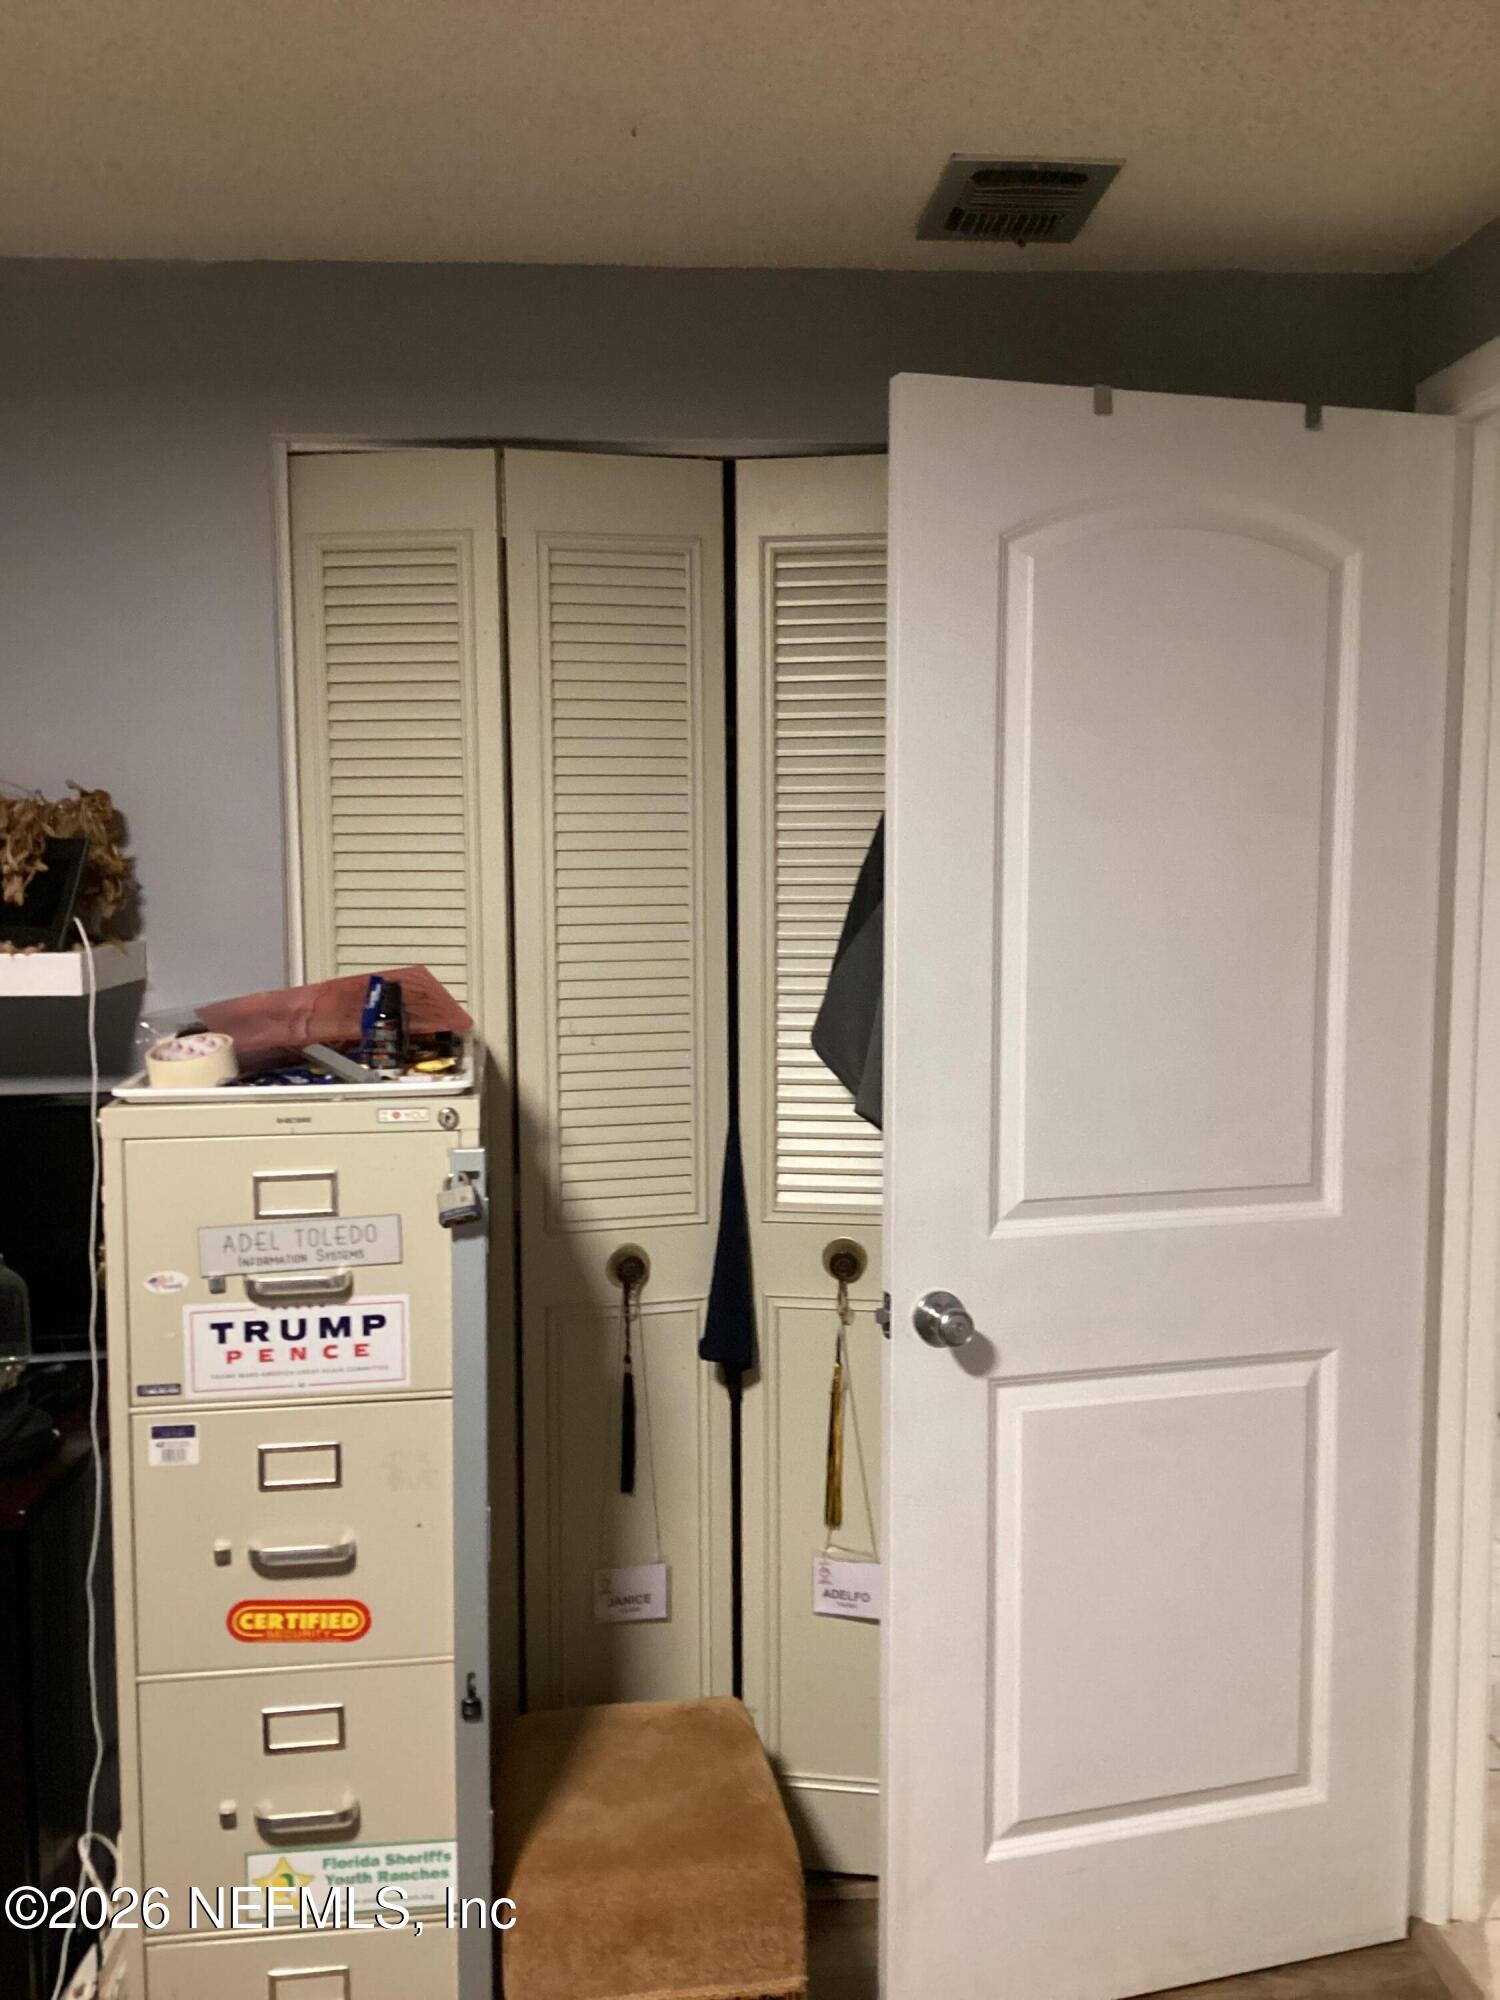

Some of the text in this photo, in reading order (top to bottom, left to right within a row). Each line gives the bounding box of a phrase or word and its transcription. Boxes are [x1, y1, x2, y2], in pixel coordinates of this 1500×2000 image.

[222, 1223, 378, 1254] ADEL TOLEDO
[209, 1313, 388, 1345] TRUMP
[225, 1343, 371, 1365] PENCE
[239, 1611, 360, 1631] CERTIFIED
[322, 1849, 453, 1870] Florida Sheriffs
[325, 1868, 450, 1886] Youth Ranches
